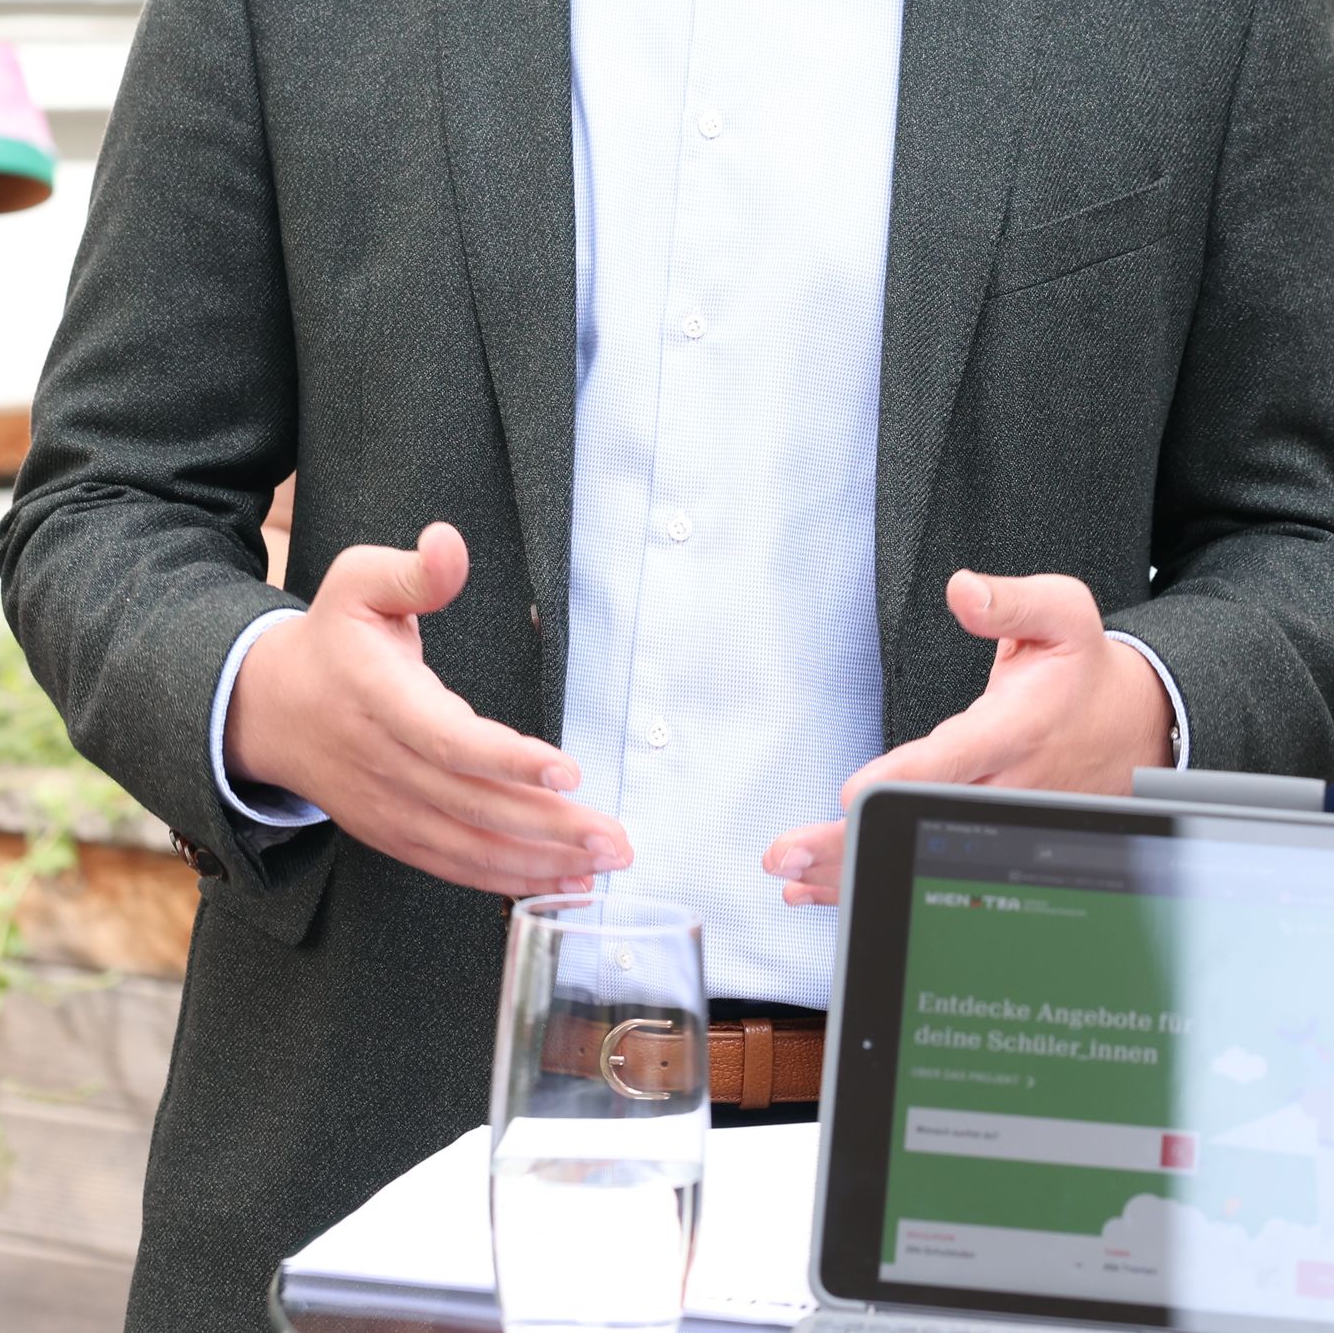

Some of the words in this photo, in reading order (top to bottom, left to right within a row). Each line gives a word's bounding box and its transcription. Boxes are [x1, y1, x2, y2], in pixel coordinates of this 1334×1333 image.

[918, 992, 1032, 1022] Entdecke
[1036, 1002, 1152, 1030] Angebote
[914, 1024, 982, 1050] deine
